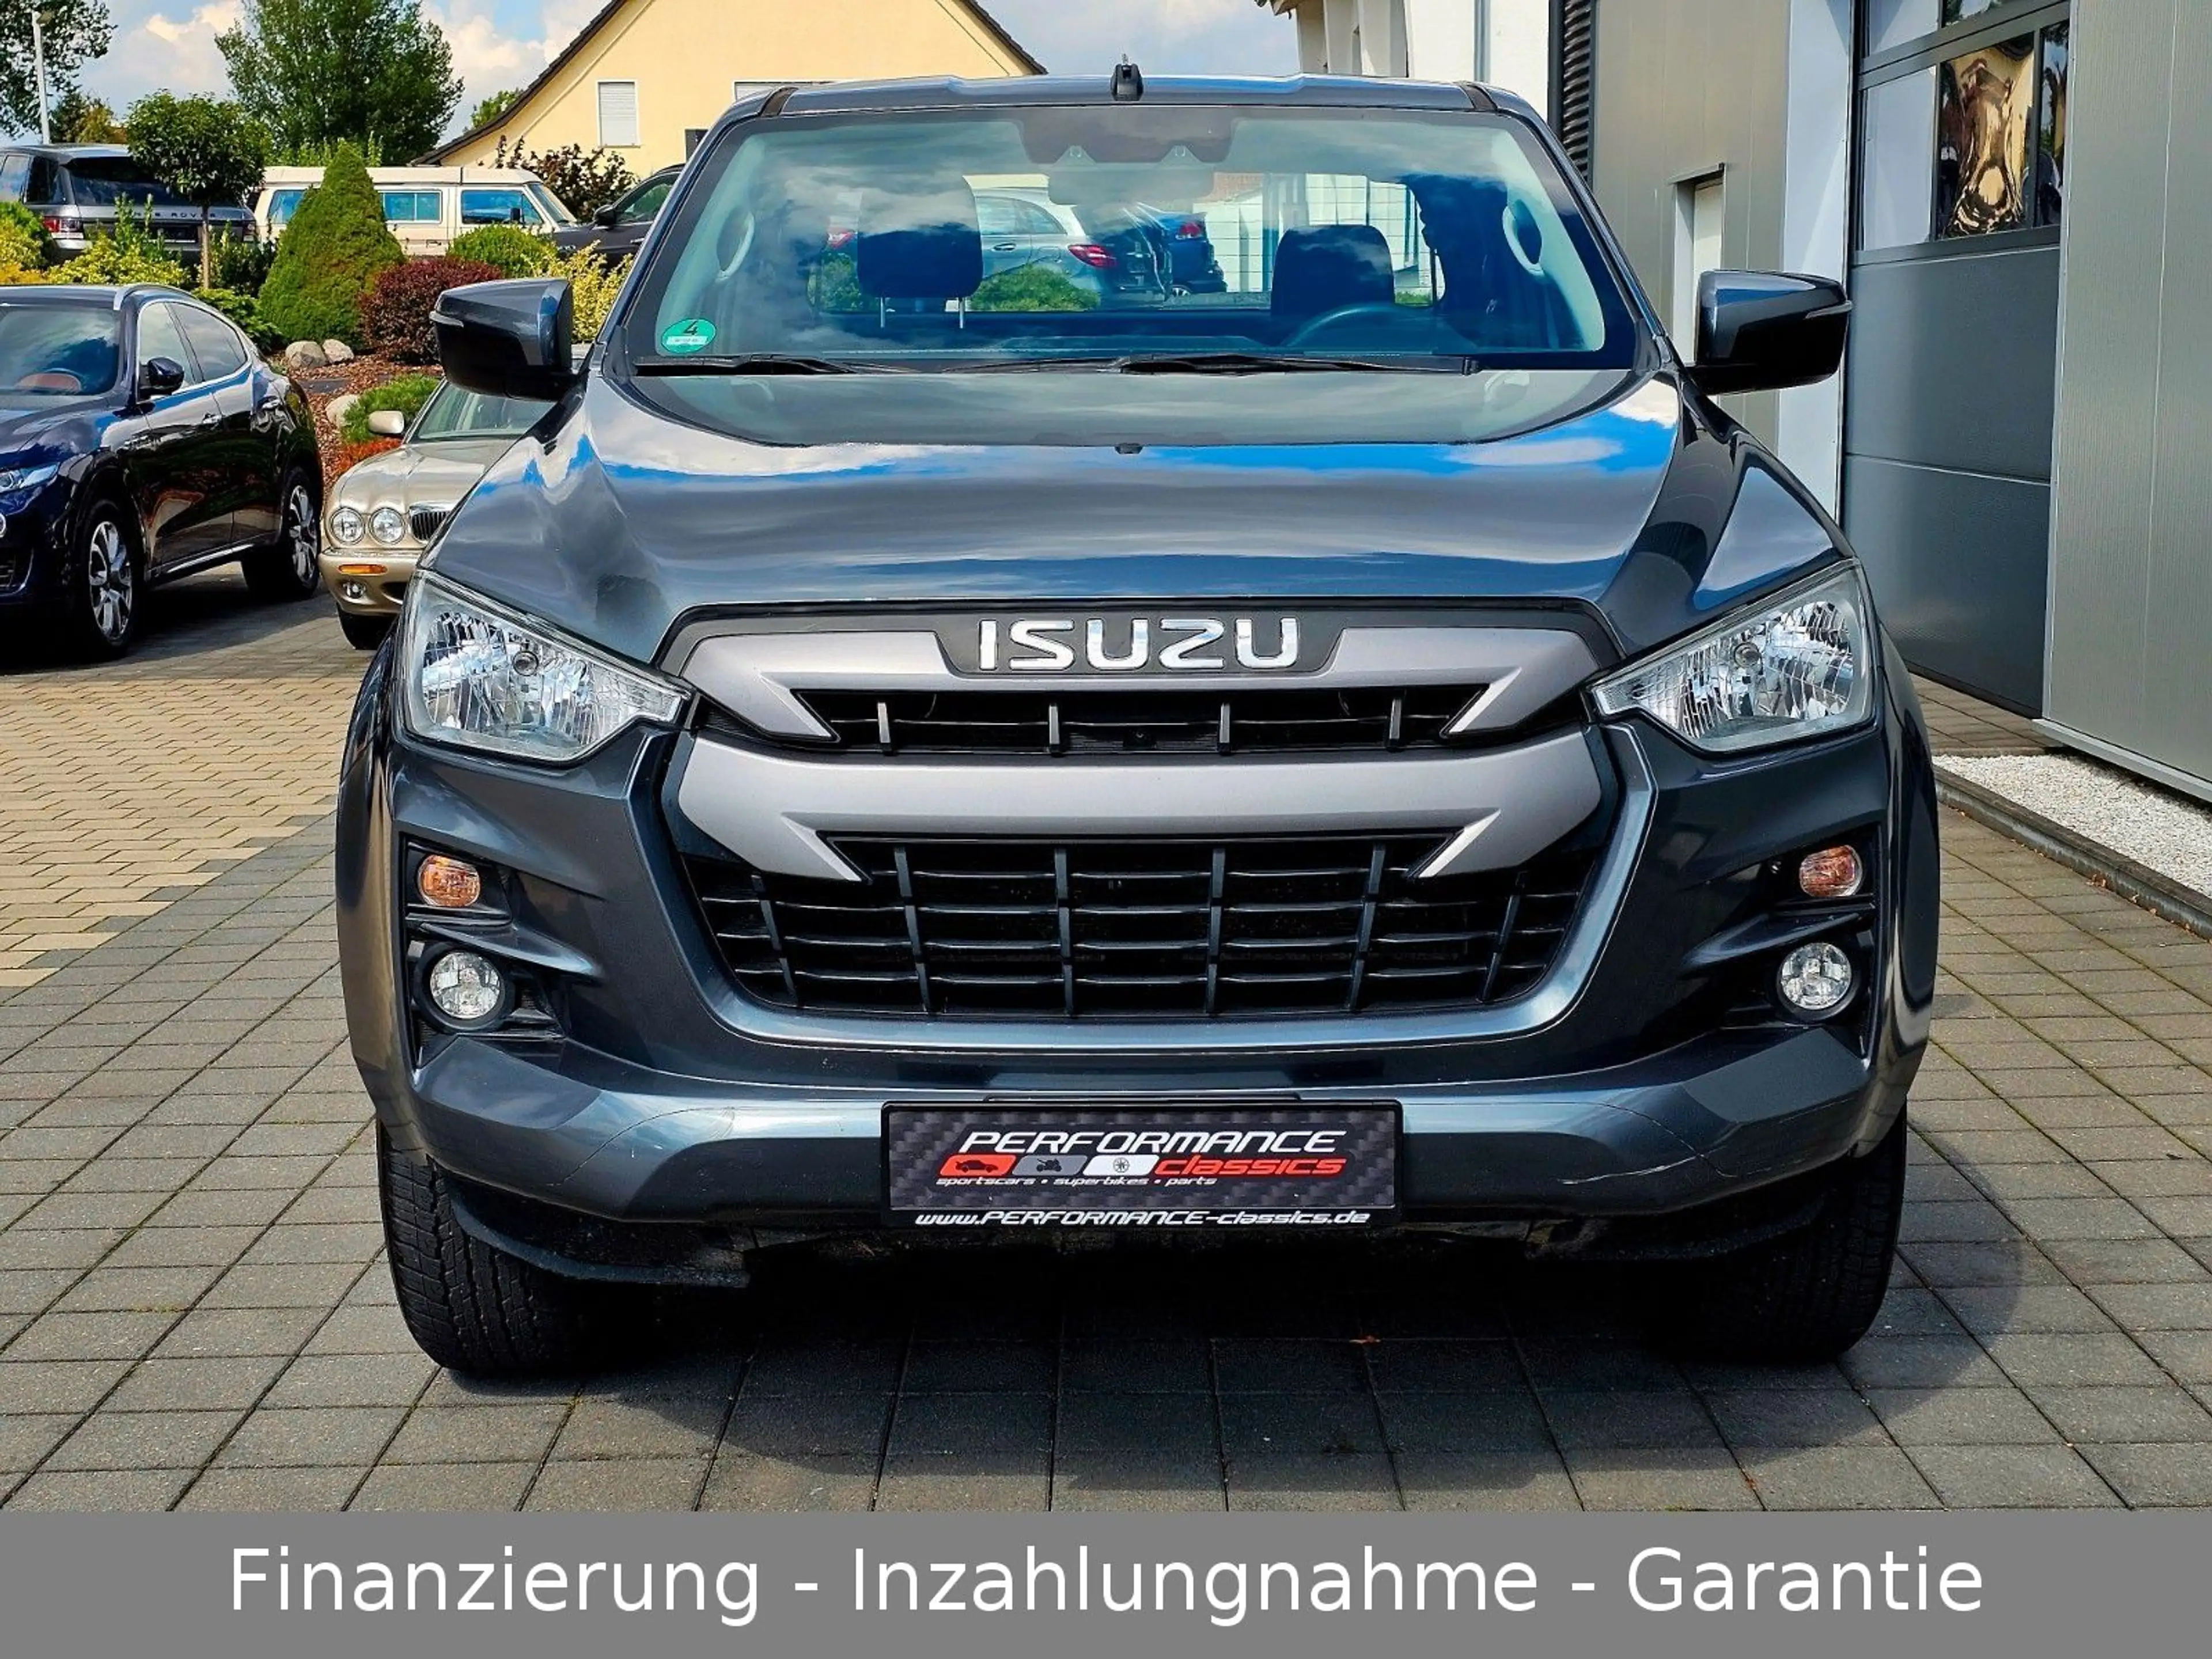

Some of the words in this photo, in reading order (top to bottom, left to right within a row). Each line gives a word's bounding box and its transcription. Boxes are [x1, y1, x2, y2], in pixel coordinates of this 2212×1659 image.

[684, 320, 698, 335] 4
[979, 619, 1298, 671] ISUZU
[959, 1131, 1347, 1154] PERFORMANCE
[1154, 1154, 1347, 1175] classics
[936, 1176, 1036, 1187] sportscars
[1053, 1175, 1149, 1187] superbikes
[1164, 1177, 1218, 1187] parts
[915, 1210, 1371, 1226] www.PERFORMANCE-classics.de
